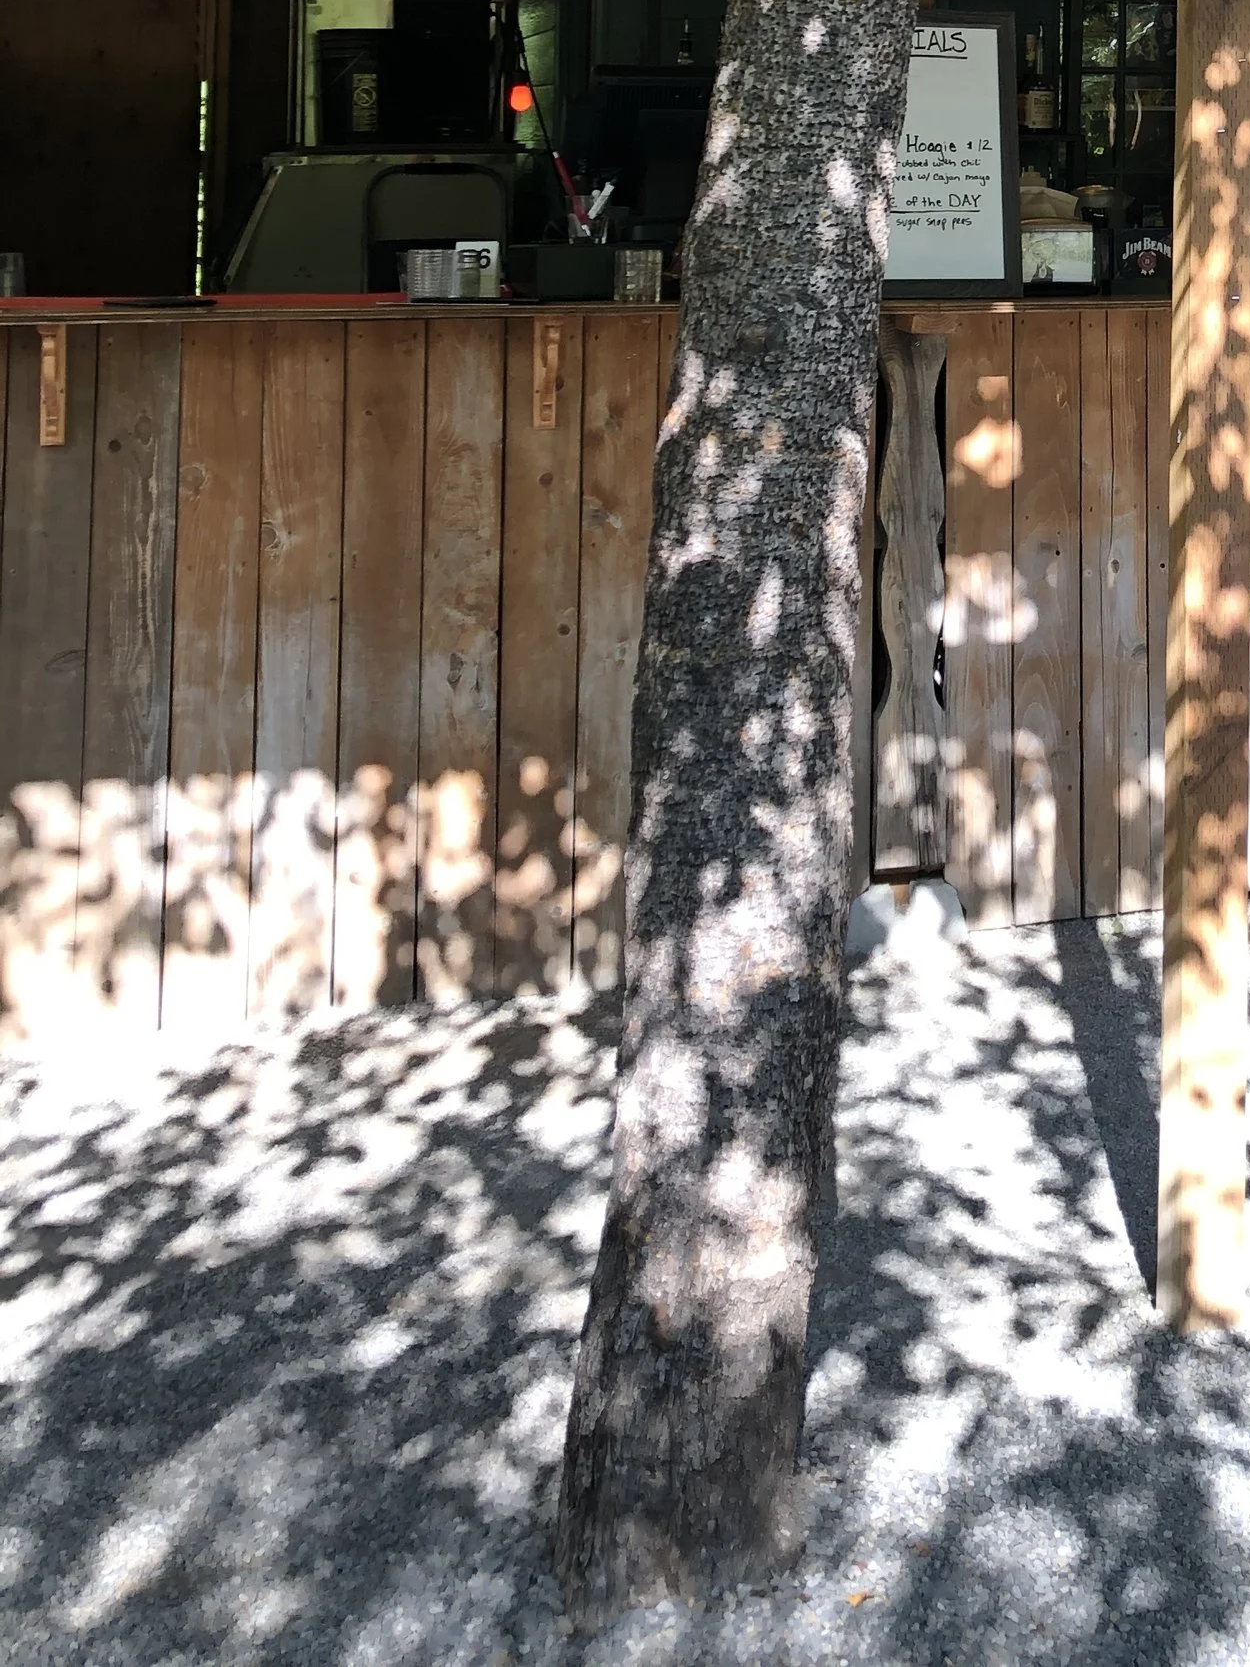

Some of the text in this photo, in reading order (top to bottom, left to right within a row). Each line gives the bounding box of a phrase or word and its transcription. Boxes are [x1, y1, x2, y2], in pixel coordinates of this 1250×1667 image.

[911, 29, 967, 53] IALS
[906, 133, 957, 162] Hoagie
[932, 157, 957, 167] with
[965, 175, 991, 186] mayo
[906, 196, 918, 206] of
[922, 197, 943, 207] the
[948, 193, 982, 208] DAY
[895, 217, 921, 231] sugar
[926, 217, 947, 230] snap
[1122, 237, 1171, 260] JIM BEAM
